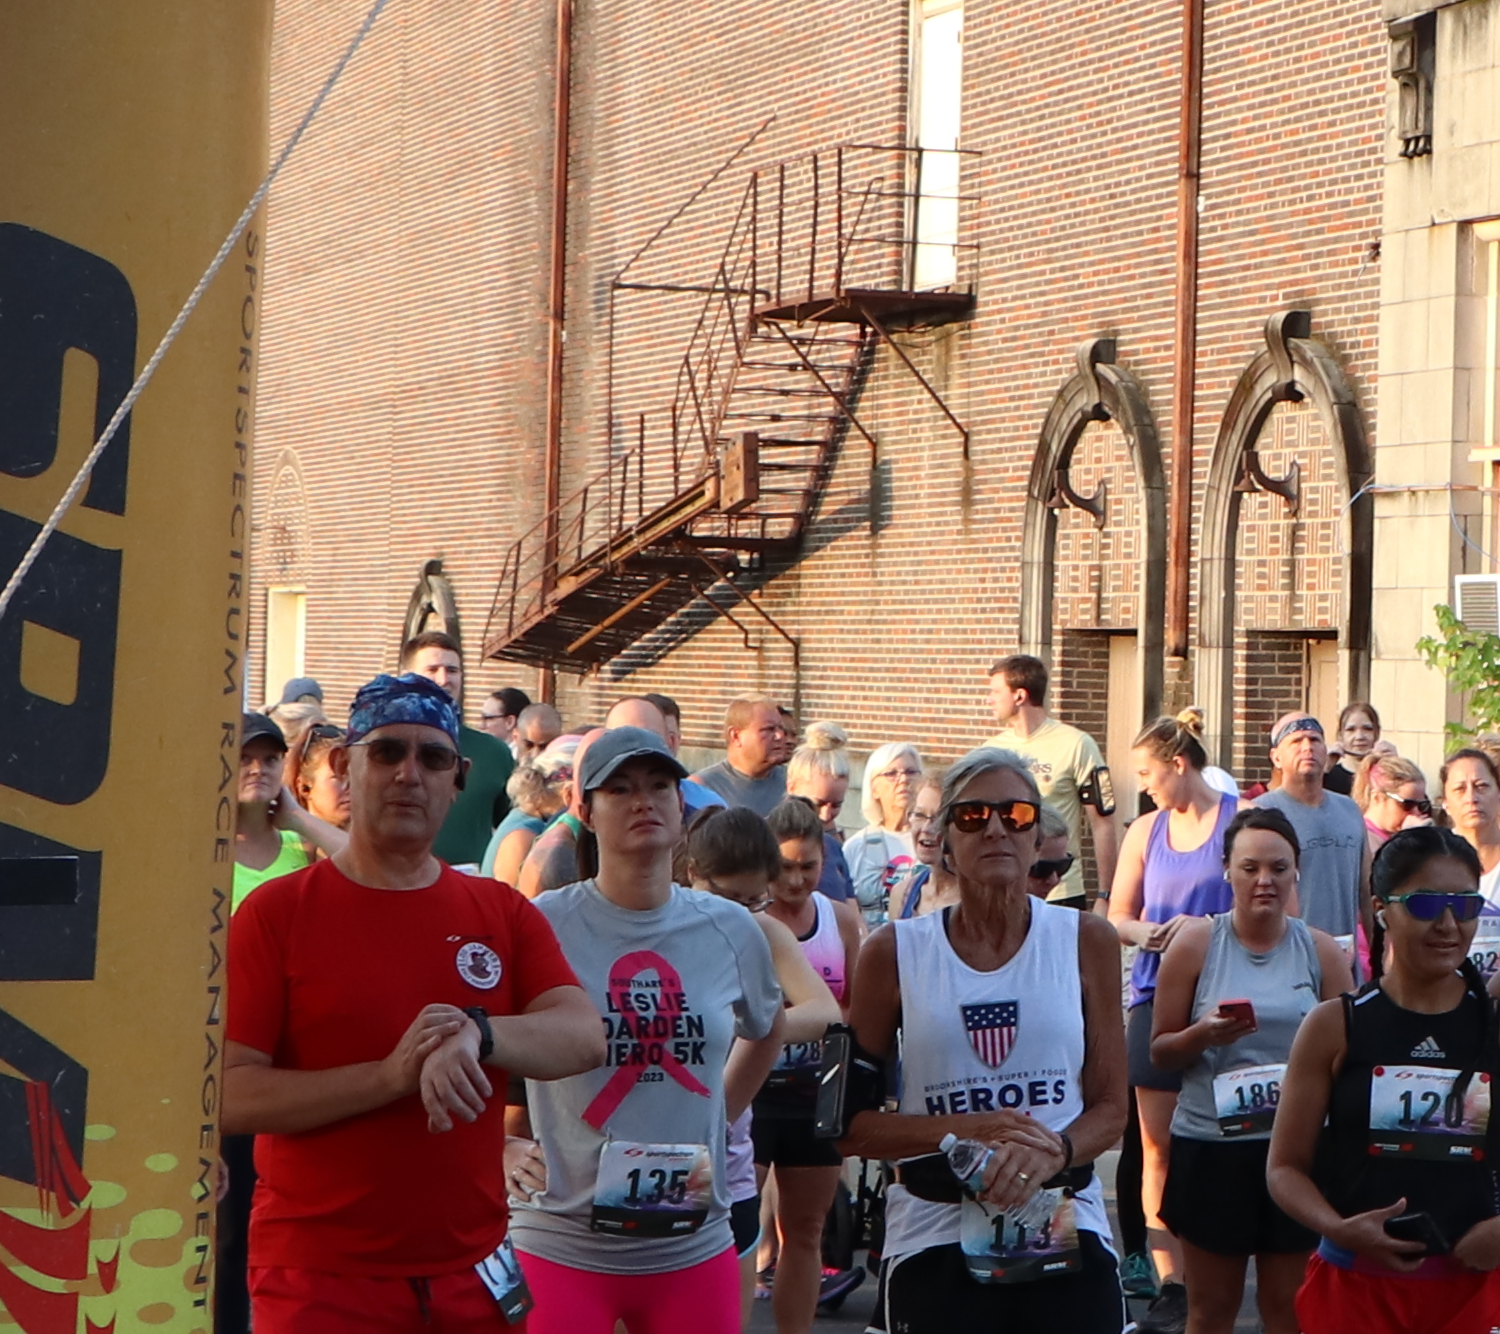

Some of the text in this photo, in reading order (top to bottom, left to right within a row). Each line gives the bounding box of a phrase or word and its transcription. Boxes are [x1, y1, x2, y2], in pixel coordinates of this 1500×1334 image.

[191, 229, 261, 1317] SPORTSPECTRUM RACE MANAGEMENT
[1472, 950, 1499, 974] 82
[605, 991, 690, 1013] LESLIE
[602, 1014, 706, 1040] DARDEN
[673, 1040, 707, 1066] 5K
[782, 1041, 821, 1066] 128
[1410, 1049, 1447, 1059] adidas
[636, 1072, 665, 1084] 2023
[998, 1070, 1030, 1082] SUPER
[925, 1078, 1067, 1116] HEROES
[1234, 1080, 1282, 1111] 186
[1398, 1089, 1464, 1129] 120
[623, 1167, 690, 1205] 135
